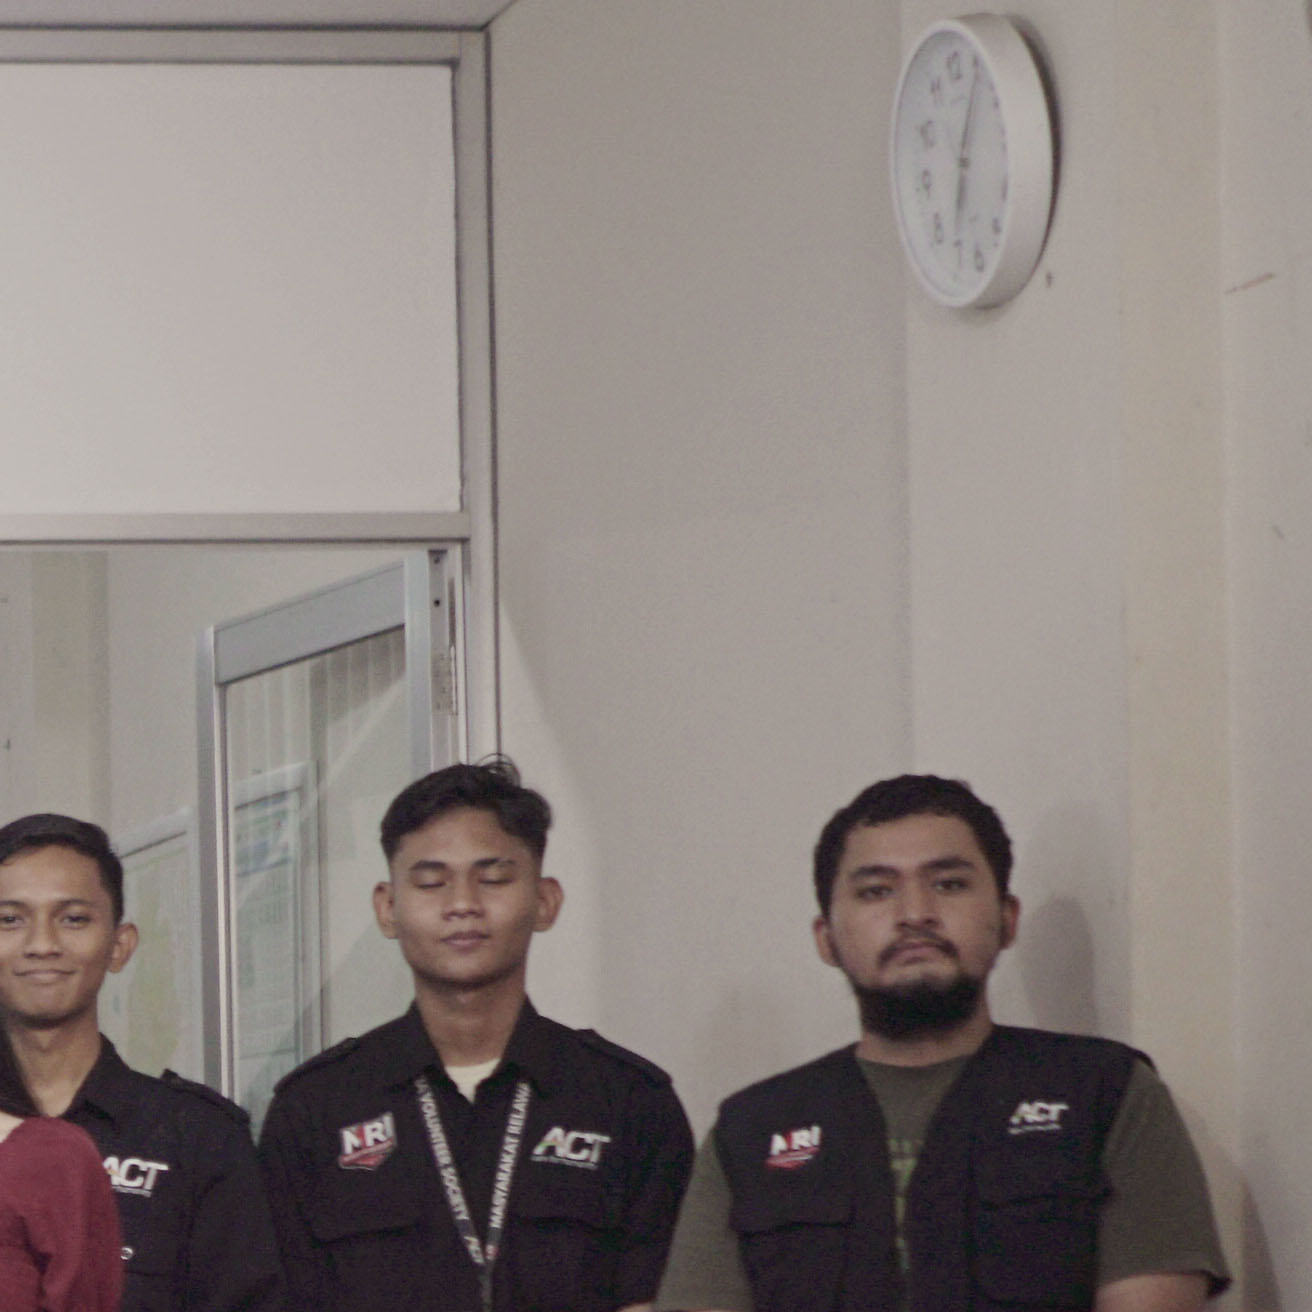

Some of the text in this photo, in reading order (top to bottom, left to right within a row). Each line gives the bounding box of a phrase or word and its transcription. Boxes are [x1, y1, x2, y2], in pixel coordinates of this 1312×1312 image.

[1009, 1100, 1070, 1125] ACT
[532, 1126, 612, 1164] ACT
[102, 1156, 169, 1190] ACT
[488, 1136, 521, 1230] MASYARAKAT
[440, 1166, 470, 1221] SOCIETY
